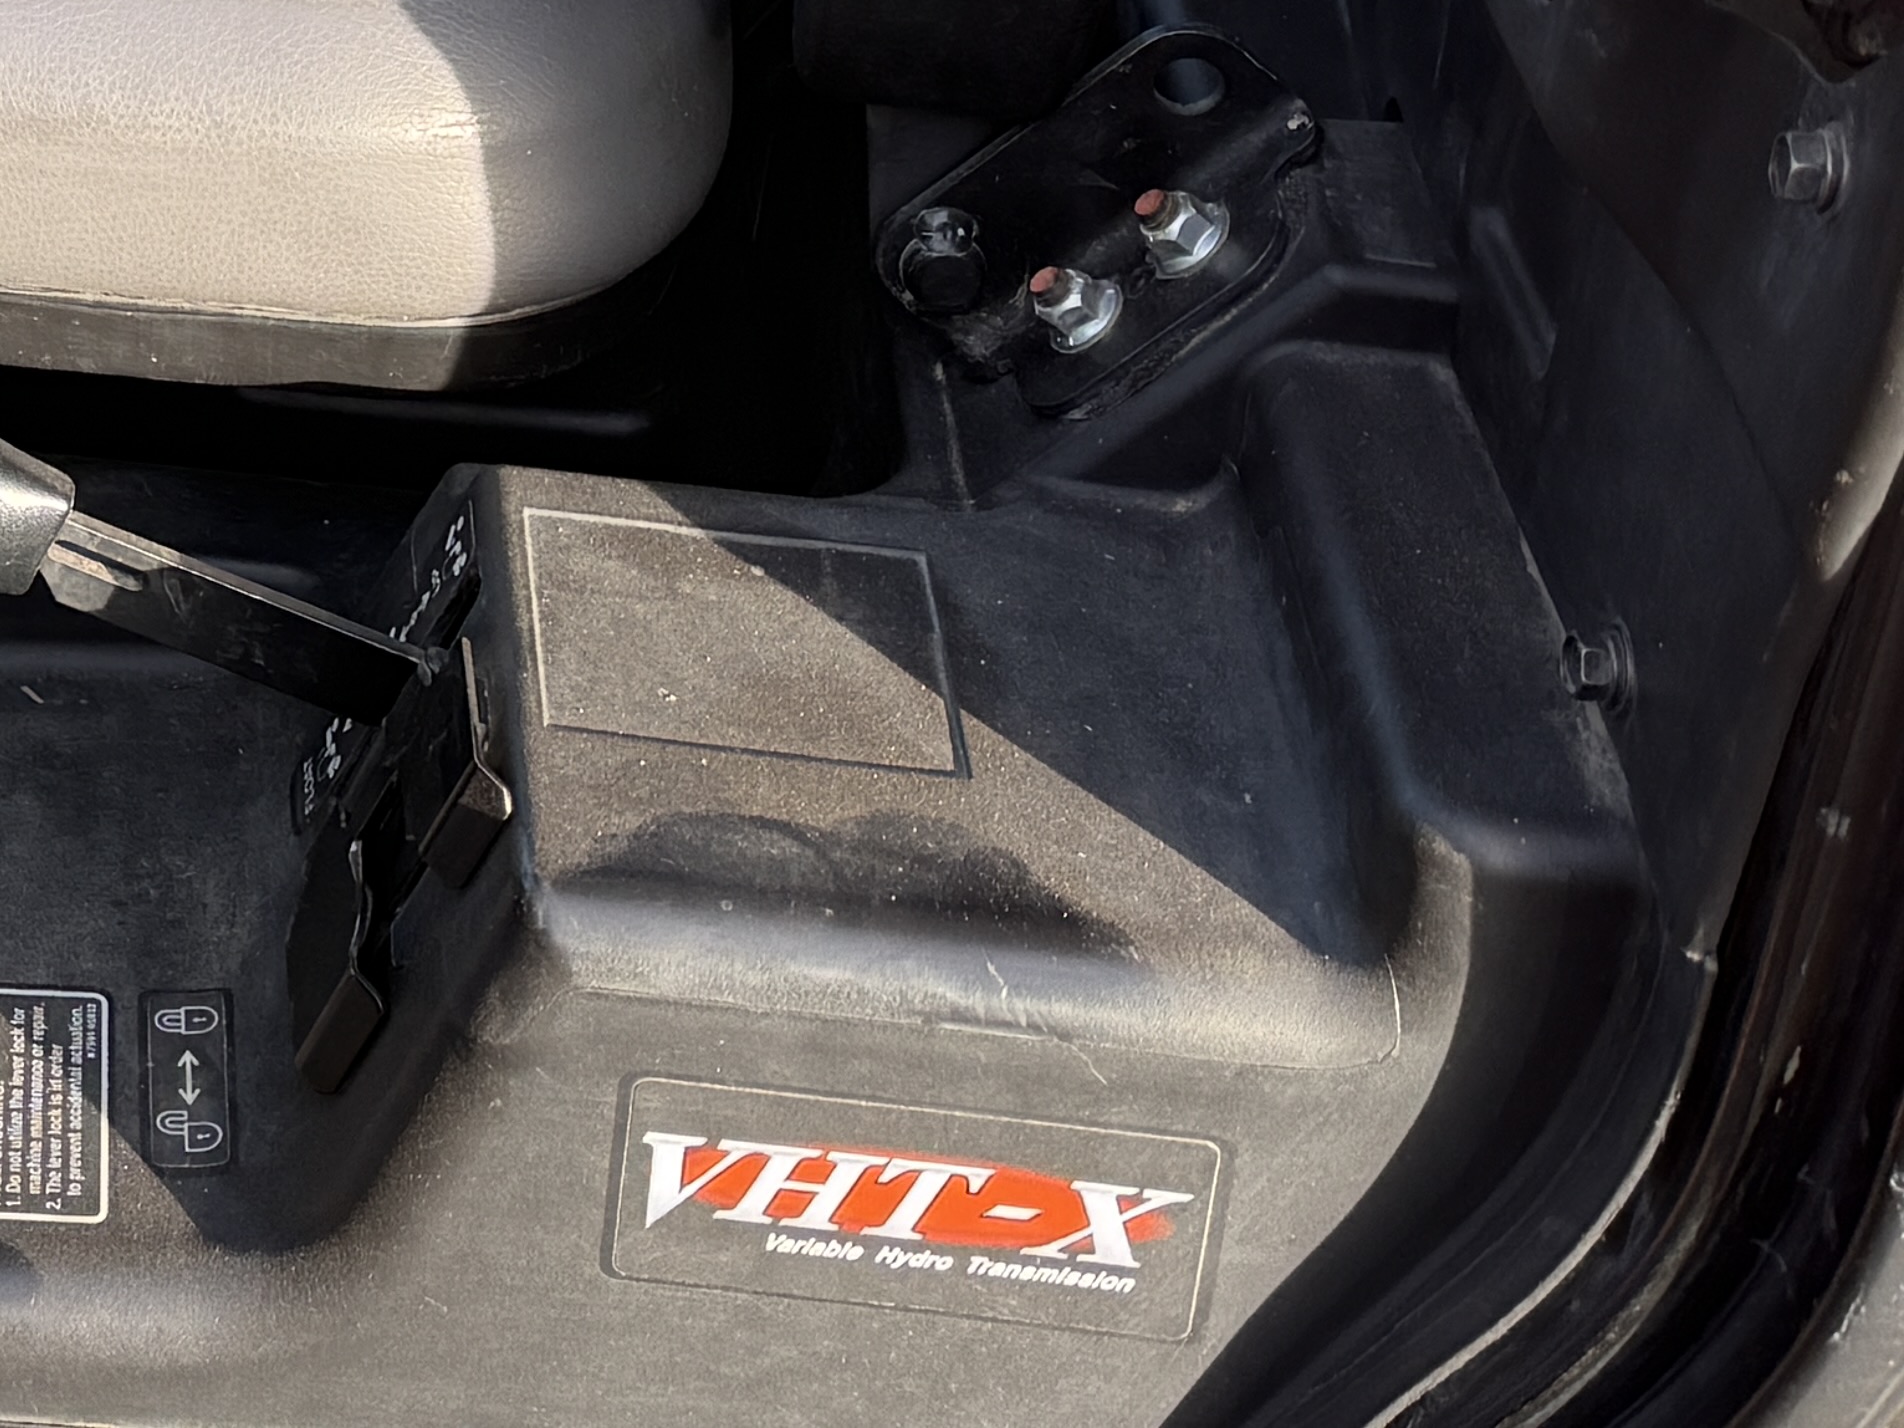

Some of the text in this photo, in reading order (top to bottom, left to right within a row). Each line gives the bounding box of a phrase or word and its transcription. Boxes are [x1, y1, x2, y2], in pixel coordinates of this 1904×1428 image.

[6, 1008, 25, 1206] 1. Do not utilize the lever lock for
[27, 1002, 48, 1194] machine maintenance or repair.
[47, 1044, 63, 1209] 2. The lever lock is in order
[67, 1006, 85, 1195] to prevent accidental actuation.
[643, 1131, 1194, 1268] VHT-X
[766, 1232, 1136, 1293] Variable Hydro Transmission
